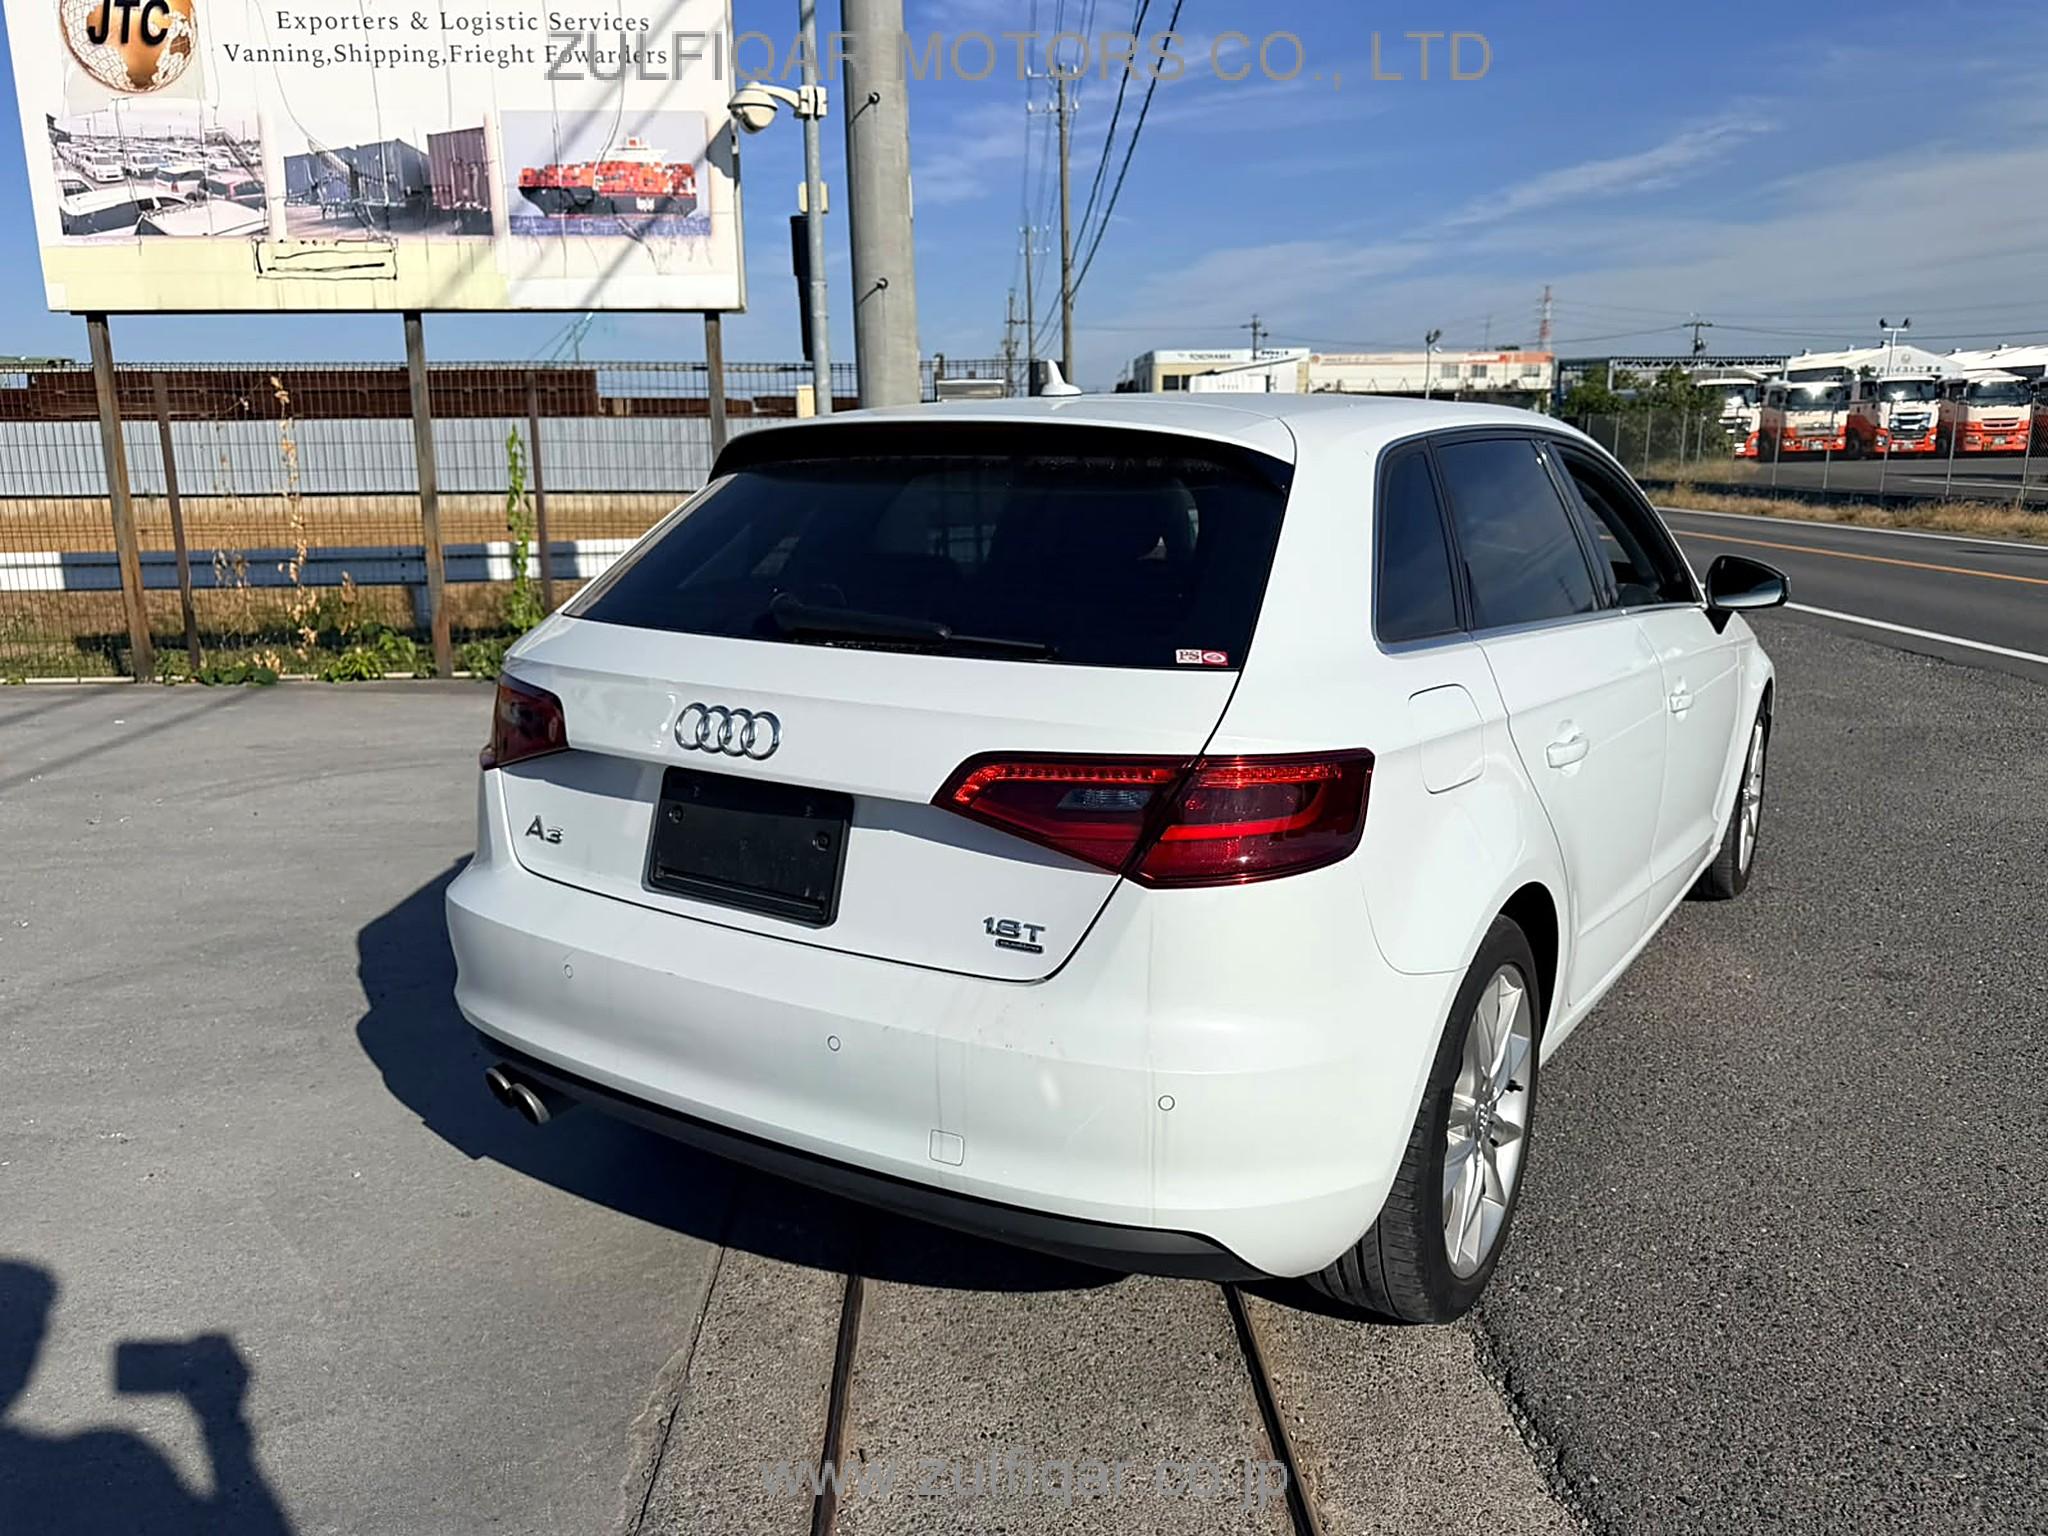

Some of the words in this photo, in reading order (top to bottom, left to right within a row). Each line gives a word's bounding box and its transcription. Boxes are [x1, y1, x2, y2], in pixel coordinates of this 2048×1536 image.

[86, 0, 170, 46] JTC
[275, 10, 400, 36] Exporters
[410, 11, 430, 31] &
[439, 11, 539, 36] Logistic
[548, 11, 651, 32] Services
[525, 814, 565, 846] A3
